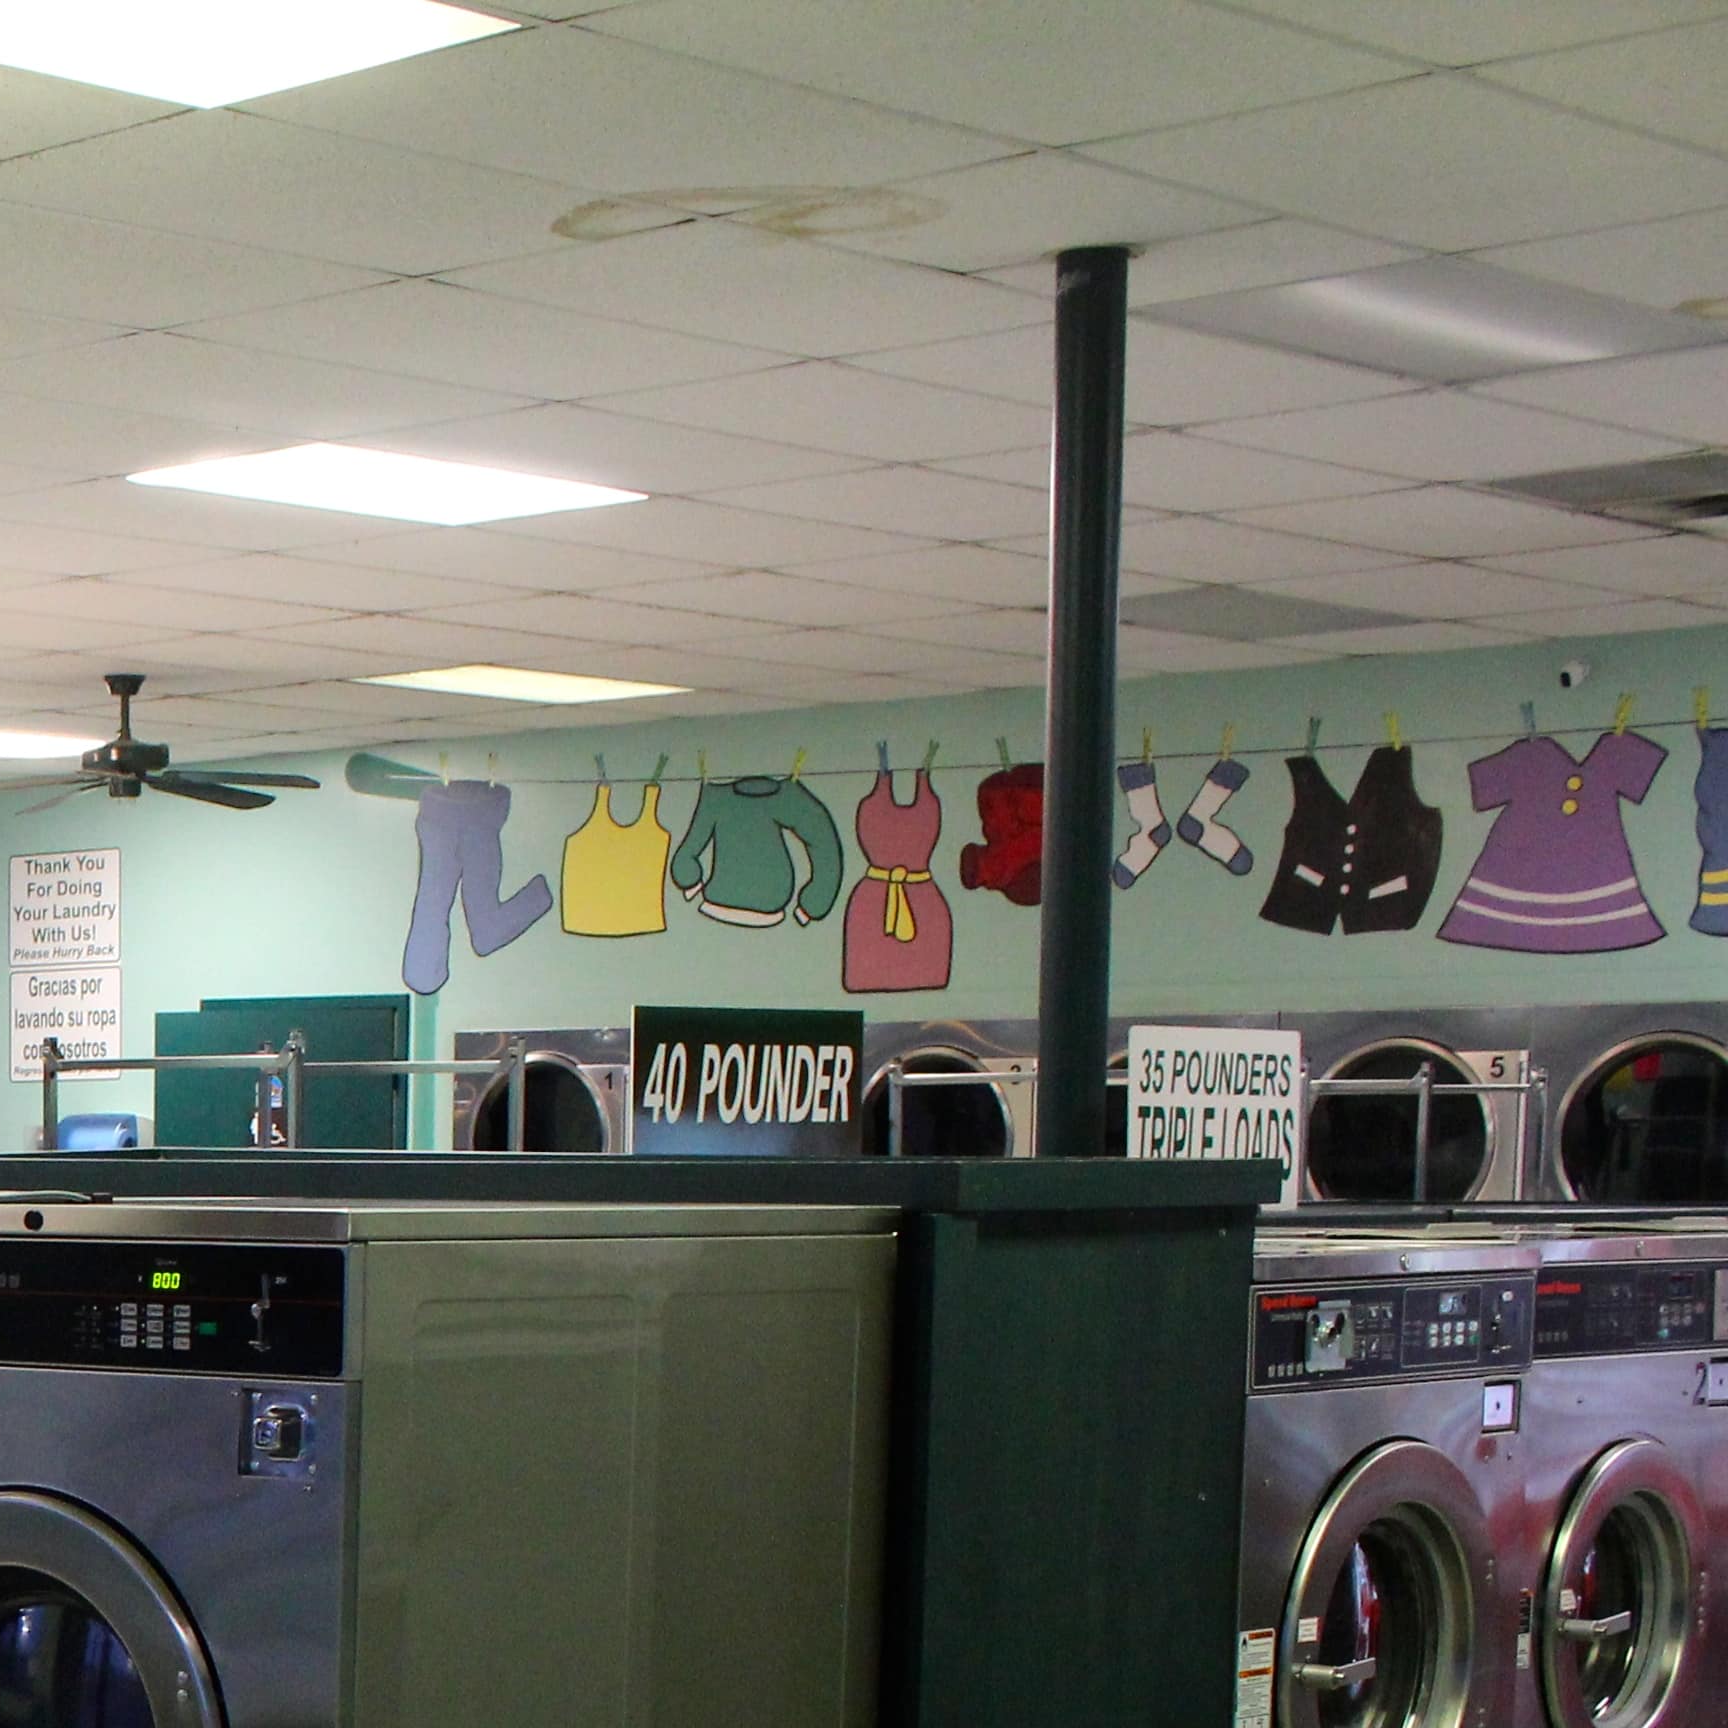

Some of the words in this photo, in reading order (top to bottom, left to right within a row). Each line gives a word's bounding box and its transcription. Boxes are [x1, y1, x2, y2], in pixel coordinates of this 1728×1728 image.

[25, 858, 71, 875] Thank
[76, 856, 105, 871] You
[27, 882, 52, 898] For
[57, 879, 102, 898] Doing
[14, 906, 48, 922] Your
[53, 902, 116, 920] Laundry
[32, 927, 66, 943] With
[71, 924, 96, 941] Us!
[13, 948, 49, 960] Please
[52, 946, 83, 959] Hurry
[86, 944, 114, 957] Back
[28, 976, 77, 997] Gracias
[80, 978, 103, 1000] por
[14, 1007, 64, 1029] lavando
[67, 1010, 83, 1027] su
[87, 1009, 116, 1030] ropa
[58, 1037, 107, 1058] osotros
[1139, 1049, 1165, 1094] 35
[1170, 1050, 1292, 1097] POUNDERS
[1489, 1056, 1505, 1079] 5
[604, 1071, 613, 1090] 1
[643, 1042, 687, 1124] 40
[697, 1043, 854, 1124] POUNDER
[152, 1272, 181, 1290] 800
